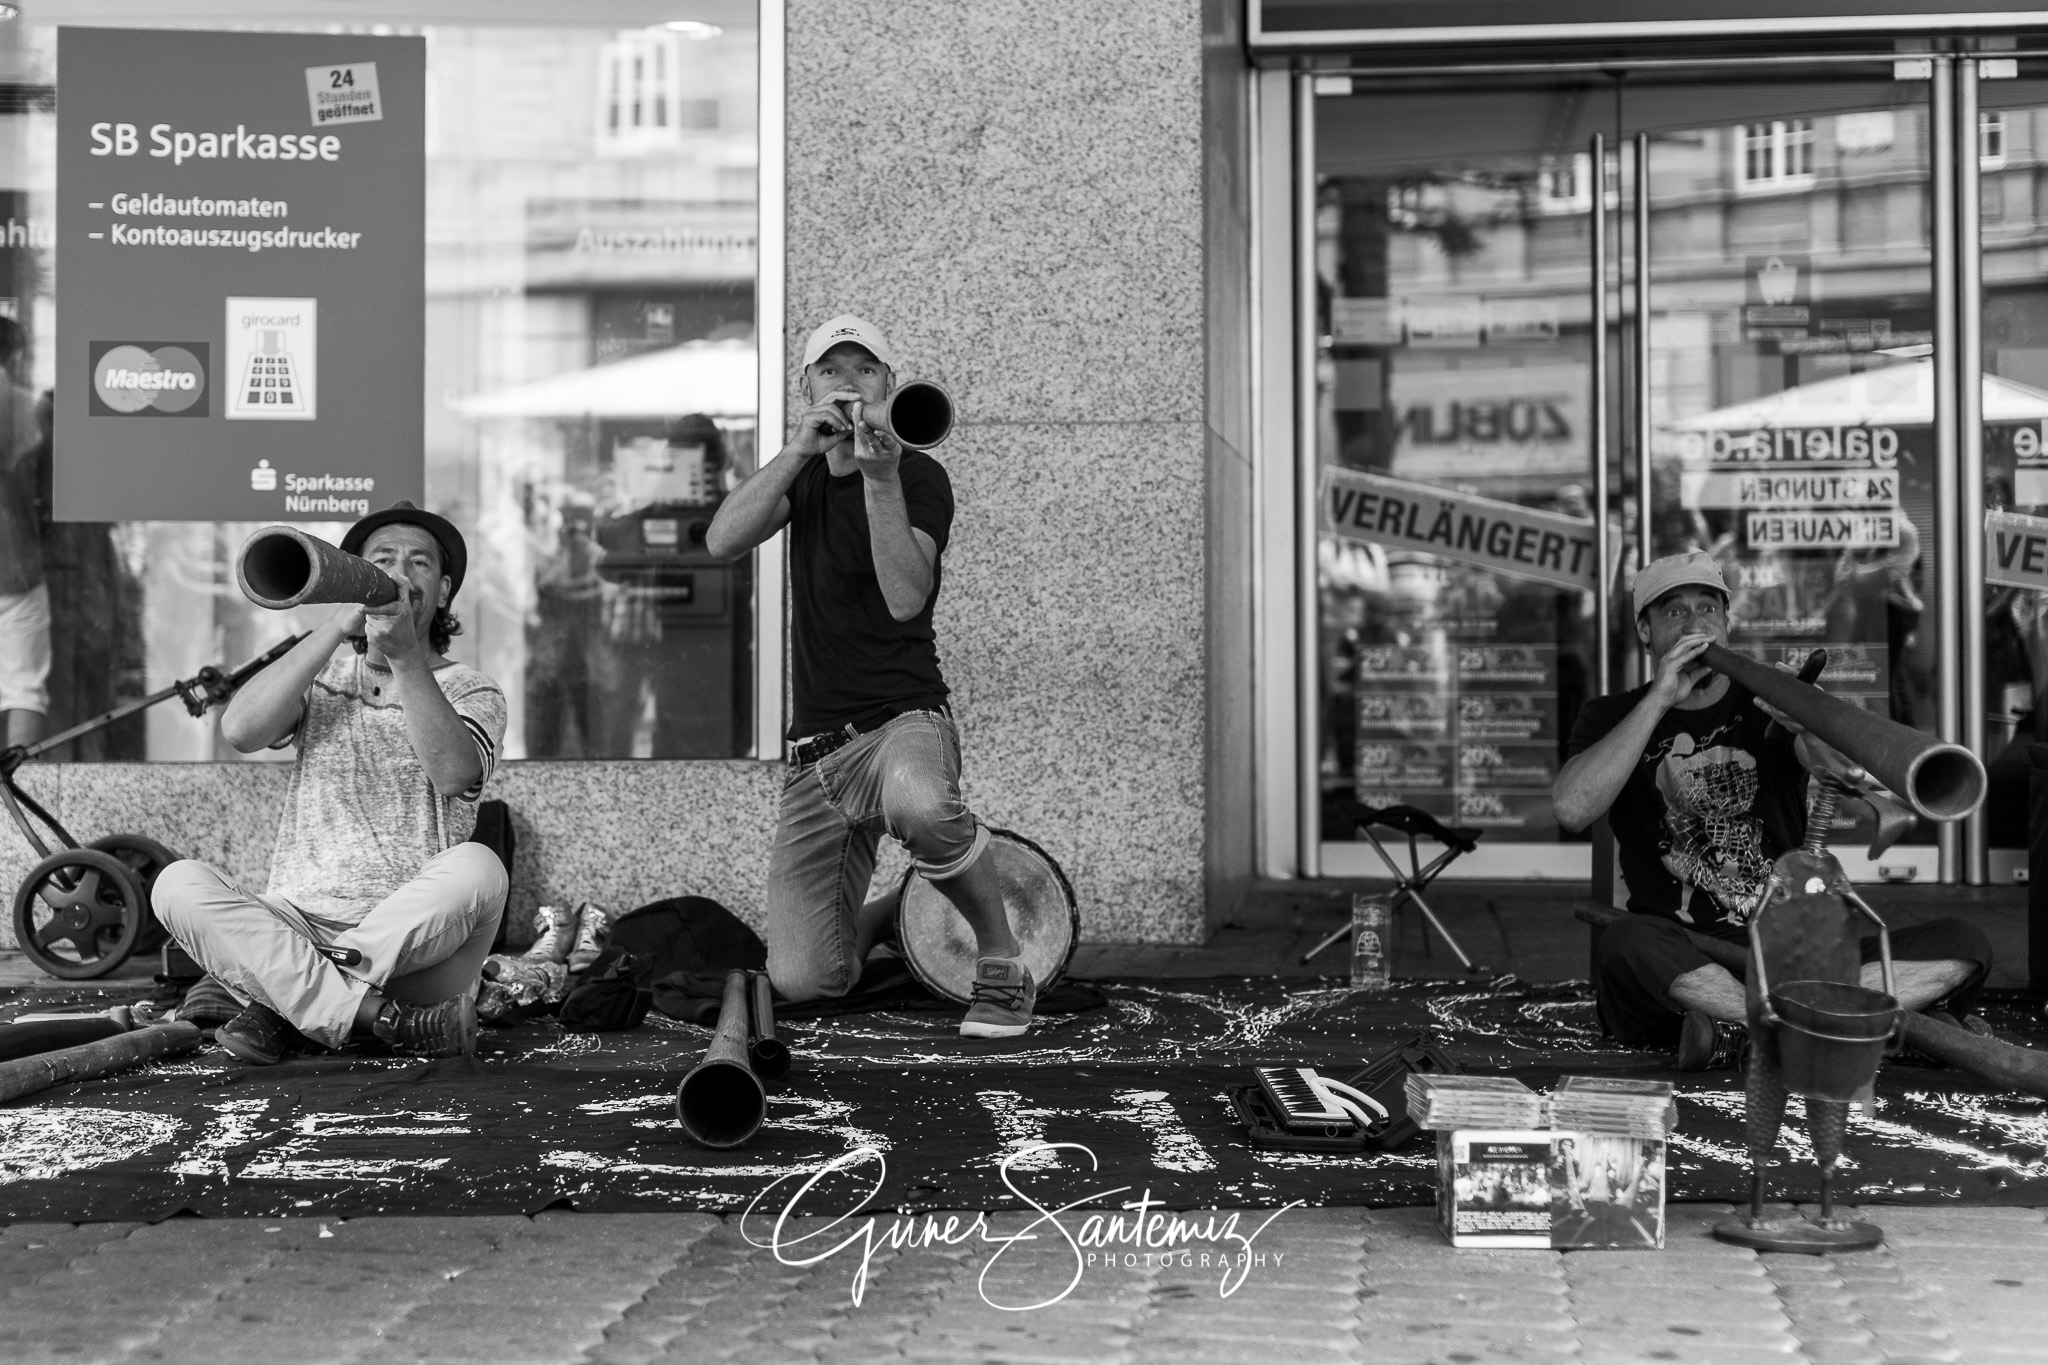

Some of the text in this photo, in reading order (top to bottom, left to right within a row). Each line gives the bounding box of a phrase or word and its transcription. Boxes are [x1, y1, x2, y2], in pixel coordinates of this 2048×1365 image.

[330, 69, 354, 88] 24
[318, 102, 375, 121] geöffnet
[90, 122, 342, 165] SB Sparkasse
[111, 192, 288, 218] Geldautomaten
[111, 223, 362, 252] Kontoauszugsdrucker
[242, 313, 300, 328] girocard
[105, 368, 197, 391] Maestro
[285, 473, 374, 494] Sparkasse
[286, 495, 369, 515] Nürnberg
[1996, 531, 2048, 573] VE
